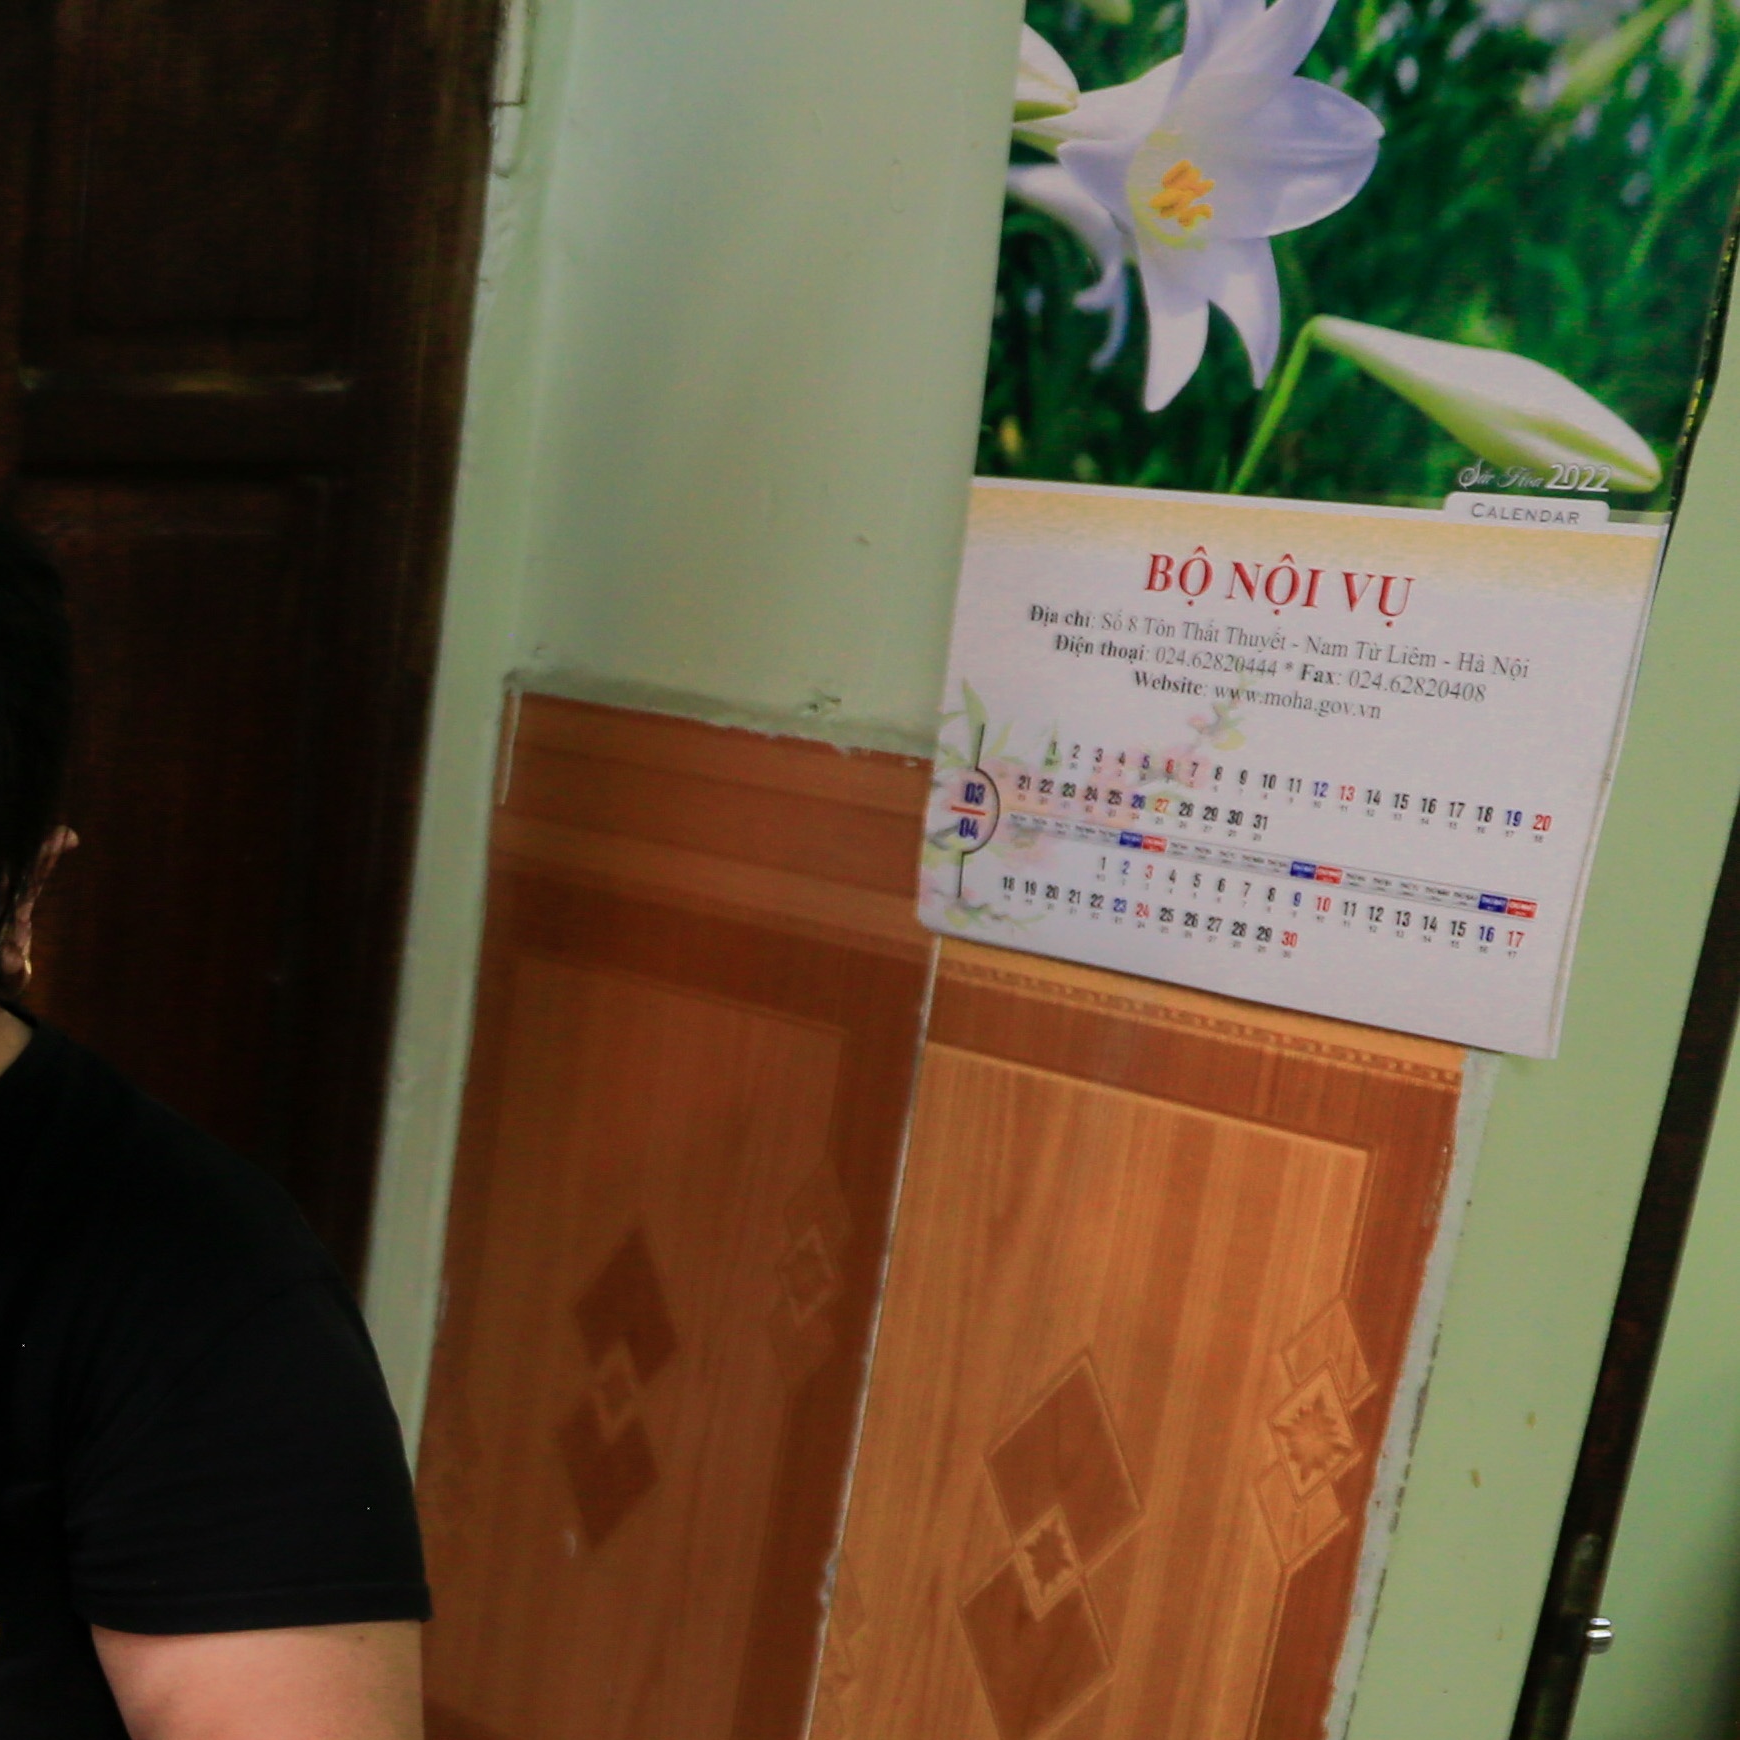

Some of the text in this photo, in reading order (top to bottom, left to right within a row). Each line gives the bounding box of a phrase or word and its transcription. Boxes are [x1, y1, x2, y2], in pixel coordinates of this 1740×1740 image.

[1472, 503, 1580, 525] CALENDAR
[1144, 545, 1417, 628] BỘ NỘI VỤ
[1029, 604, 1059, 628] Địa
[1128, 615, 1138, 632] 8
[1145, 617, 1176, 638] Tôn
[1183, 618, 1222, 643] Thất
[1226, 625, 1287, 655] Thuyết
[1305, 634, 1349, 659] Nam
[1356, 639, 1381, 662] Từ
[1386, 643, 1437, 669] Liêm
[1457, 651, 1485, 675] Hà
[1491, 655, 1531, 681] Nội
[1055, 632, 1487, 702] Điện thoại: 024.62820444 Fax: 024.62820408
[1132, 669, 1382, 721] Website: www.moha.gov.vn
[964, 782, 986, 805] 03
[1262, 773, 1552, 832] 10 11 12 13 14 15 16 17 18 19 20
[959, 817, 979, 840] 04
